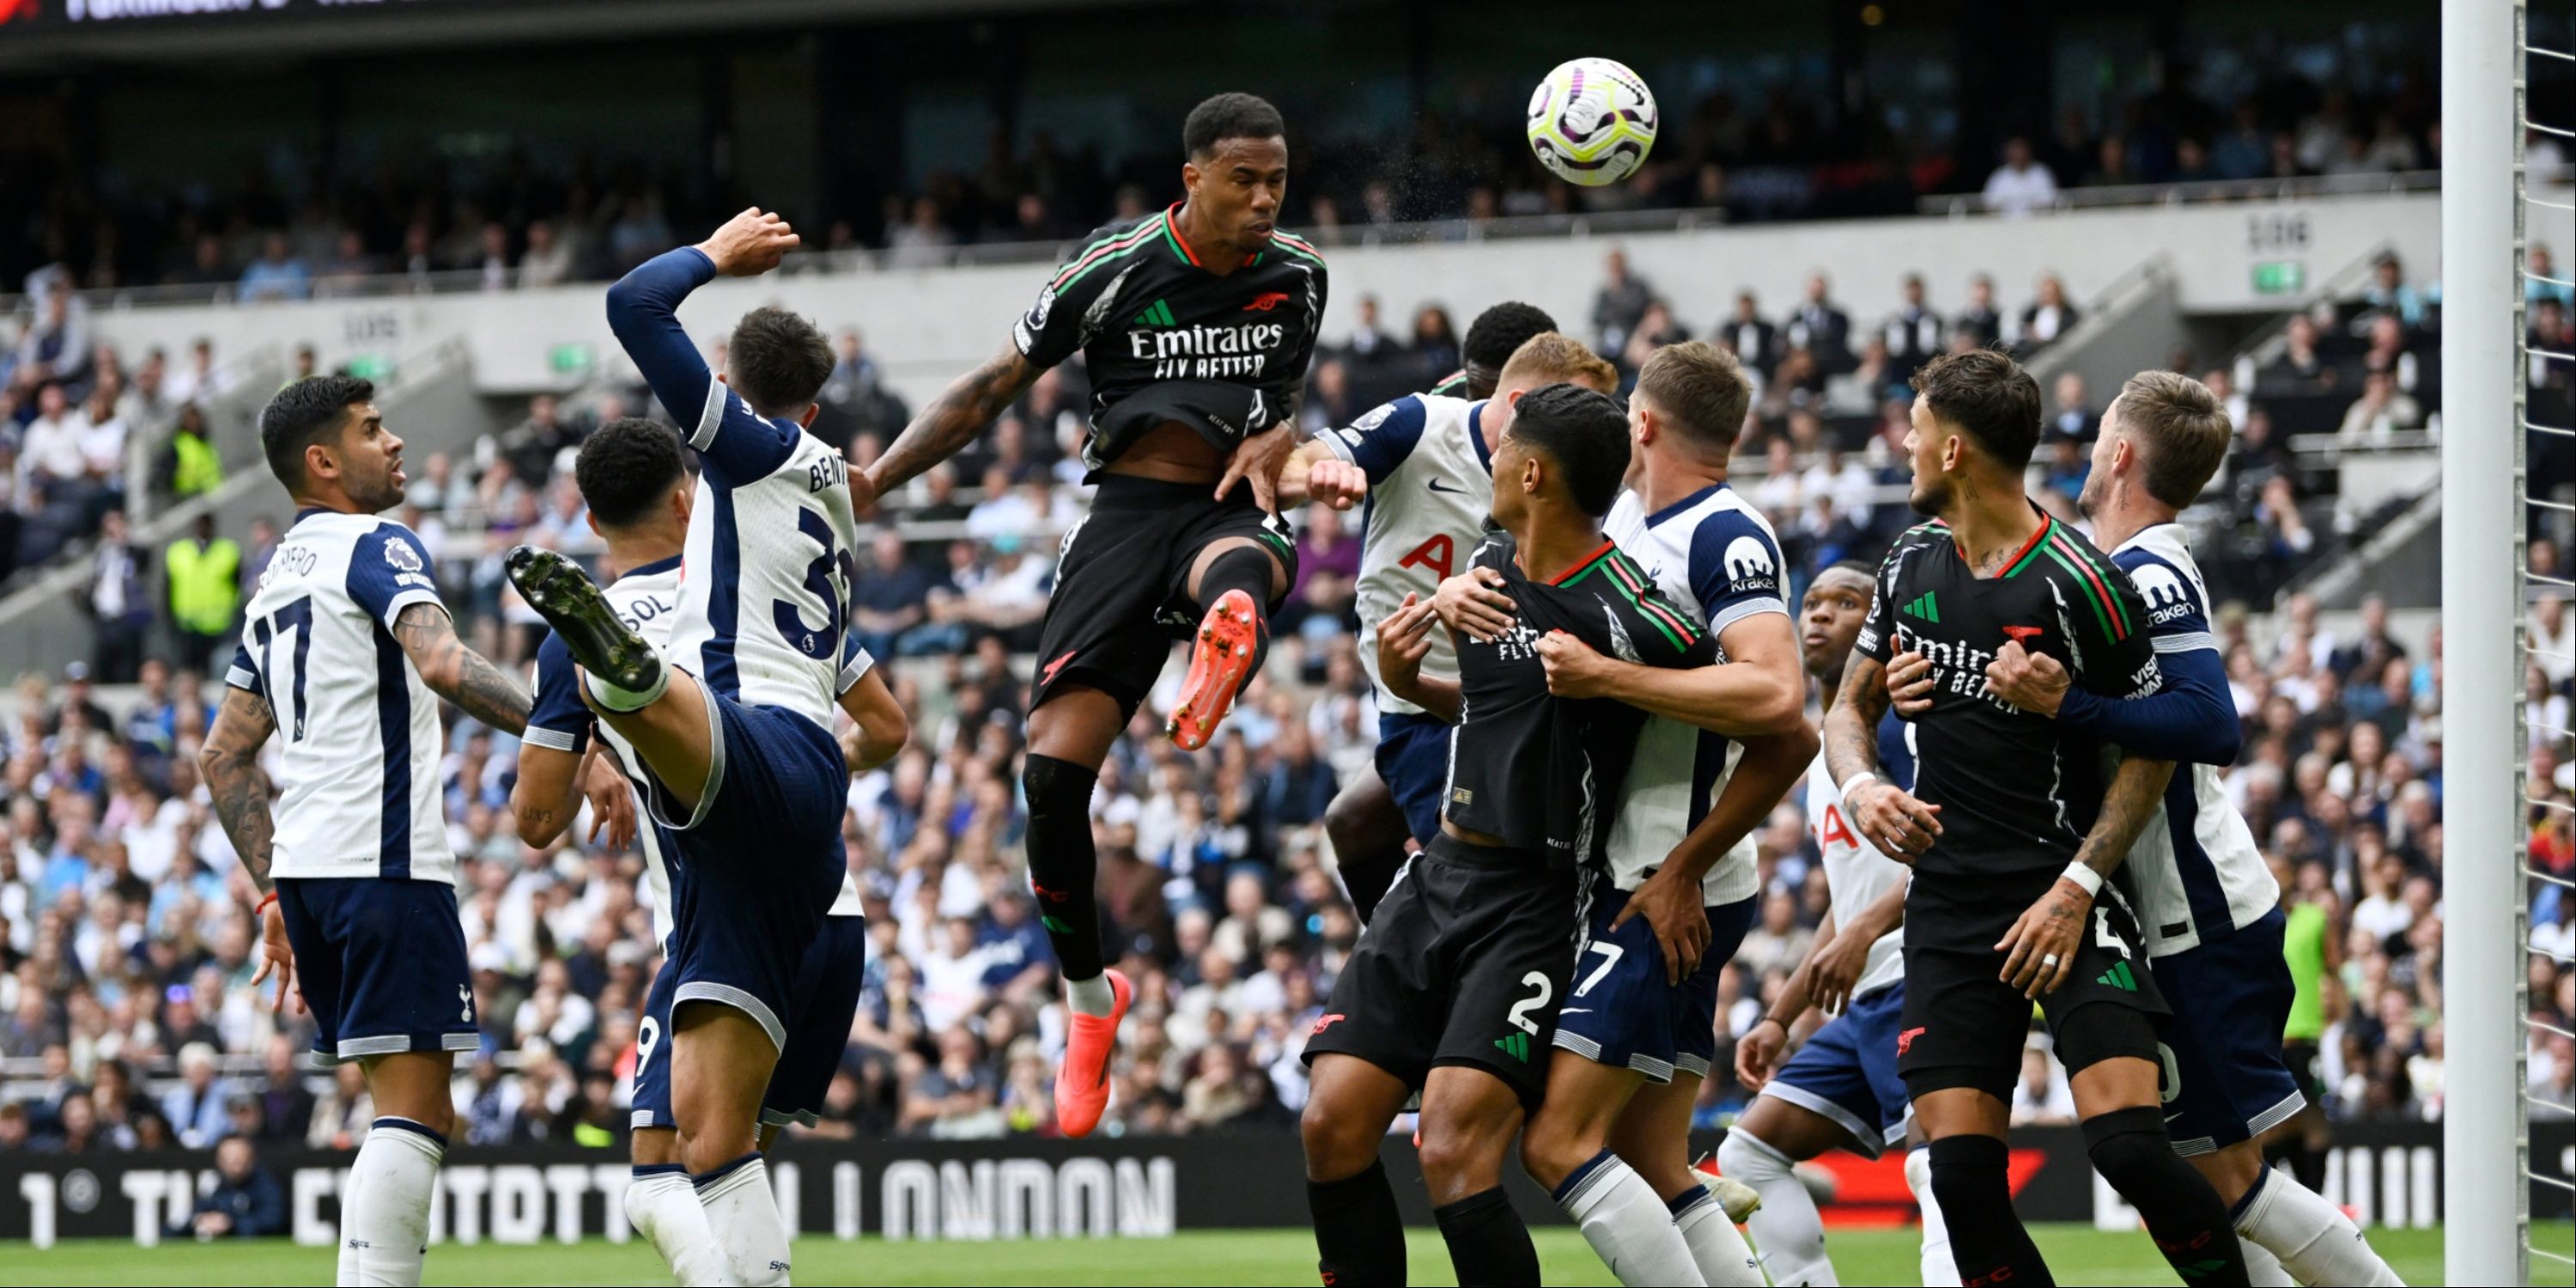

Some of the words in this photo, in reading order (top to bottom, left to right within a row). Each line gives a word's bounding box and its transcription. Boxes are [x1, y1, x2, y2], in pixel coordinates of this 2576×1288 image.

[1127, 323, 1283, 360] Emirates
[1196, 354, 1265, 379] BETTER
[260, 544, 317, 592] OMERO
[1730, 577, 1777, 592] krake
[2147, 601, 2195, 629] raken
[253, 595, 313, 744] 17
[1896, 621, 1998, 671] Emir
[1950, 671, 2019, 716] BET
[2095, 907, 2131, 960] 4
[1507, 970, 1553, 1036] 2
[636, 1015, 660, 1078] 9
